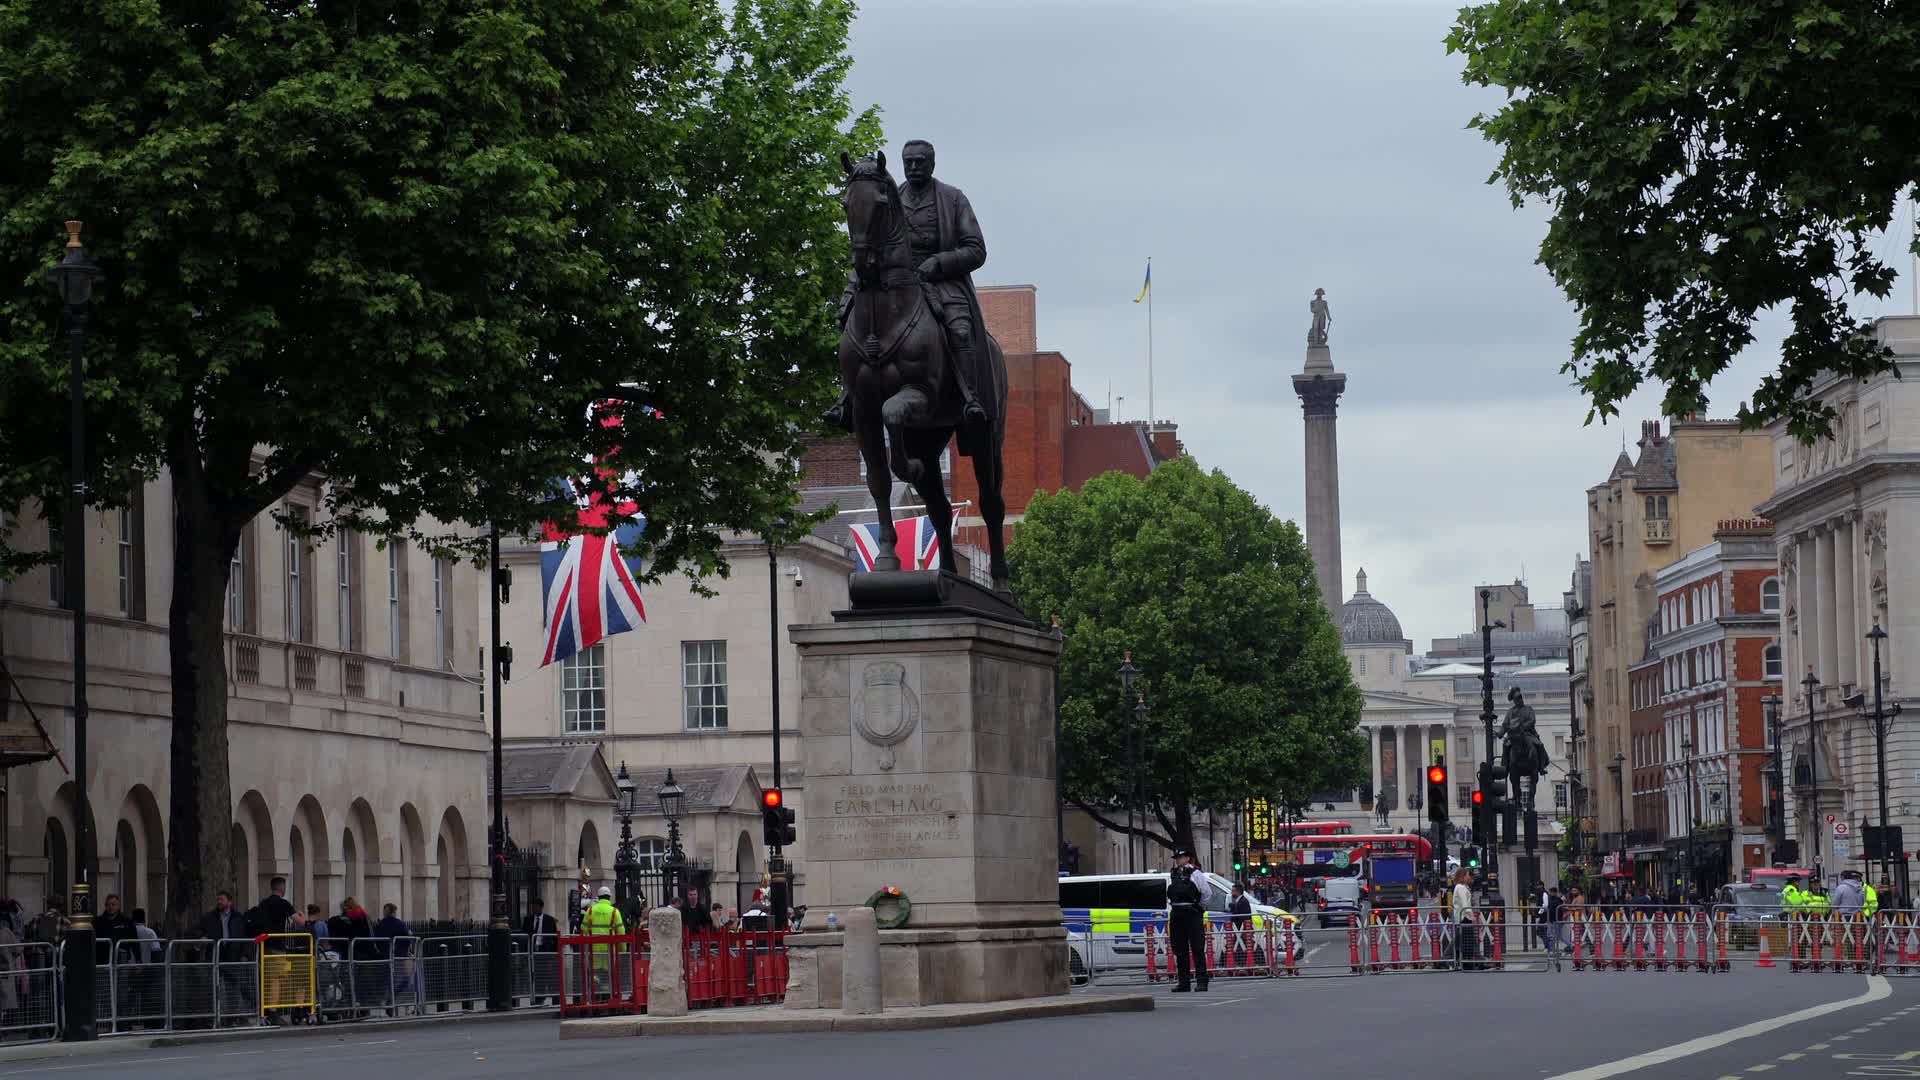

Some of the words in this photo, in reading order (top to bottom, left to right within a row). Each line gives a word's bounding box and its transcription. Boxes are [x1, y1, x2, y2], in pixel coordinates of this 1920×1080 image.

[878, 783, 937, 794] MARHAL
[834, 800, 883, 815] EARL
[891, 799, 943, 813] HAIG
